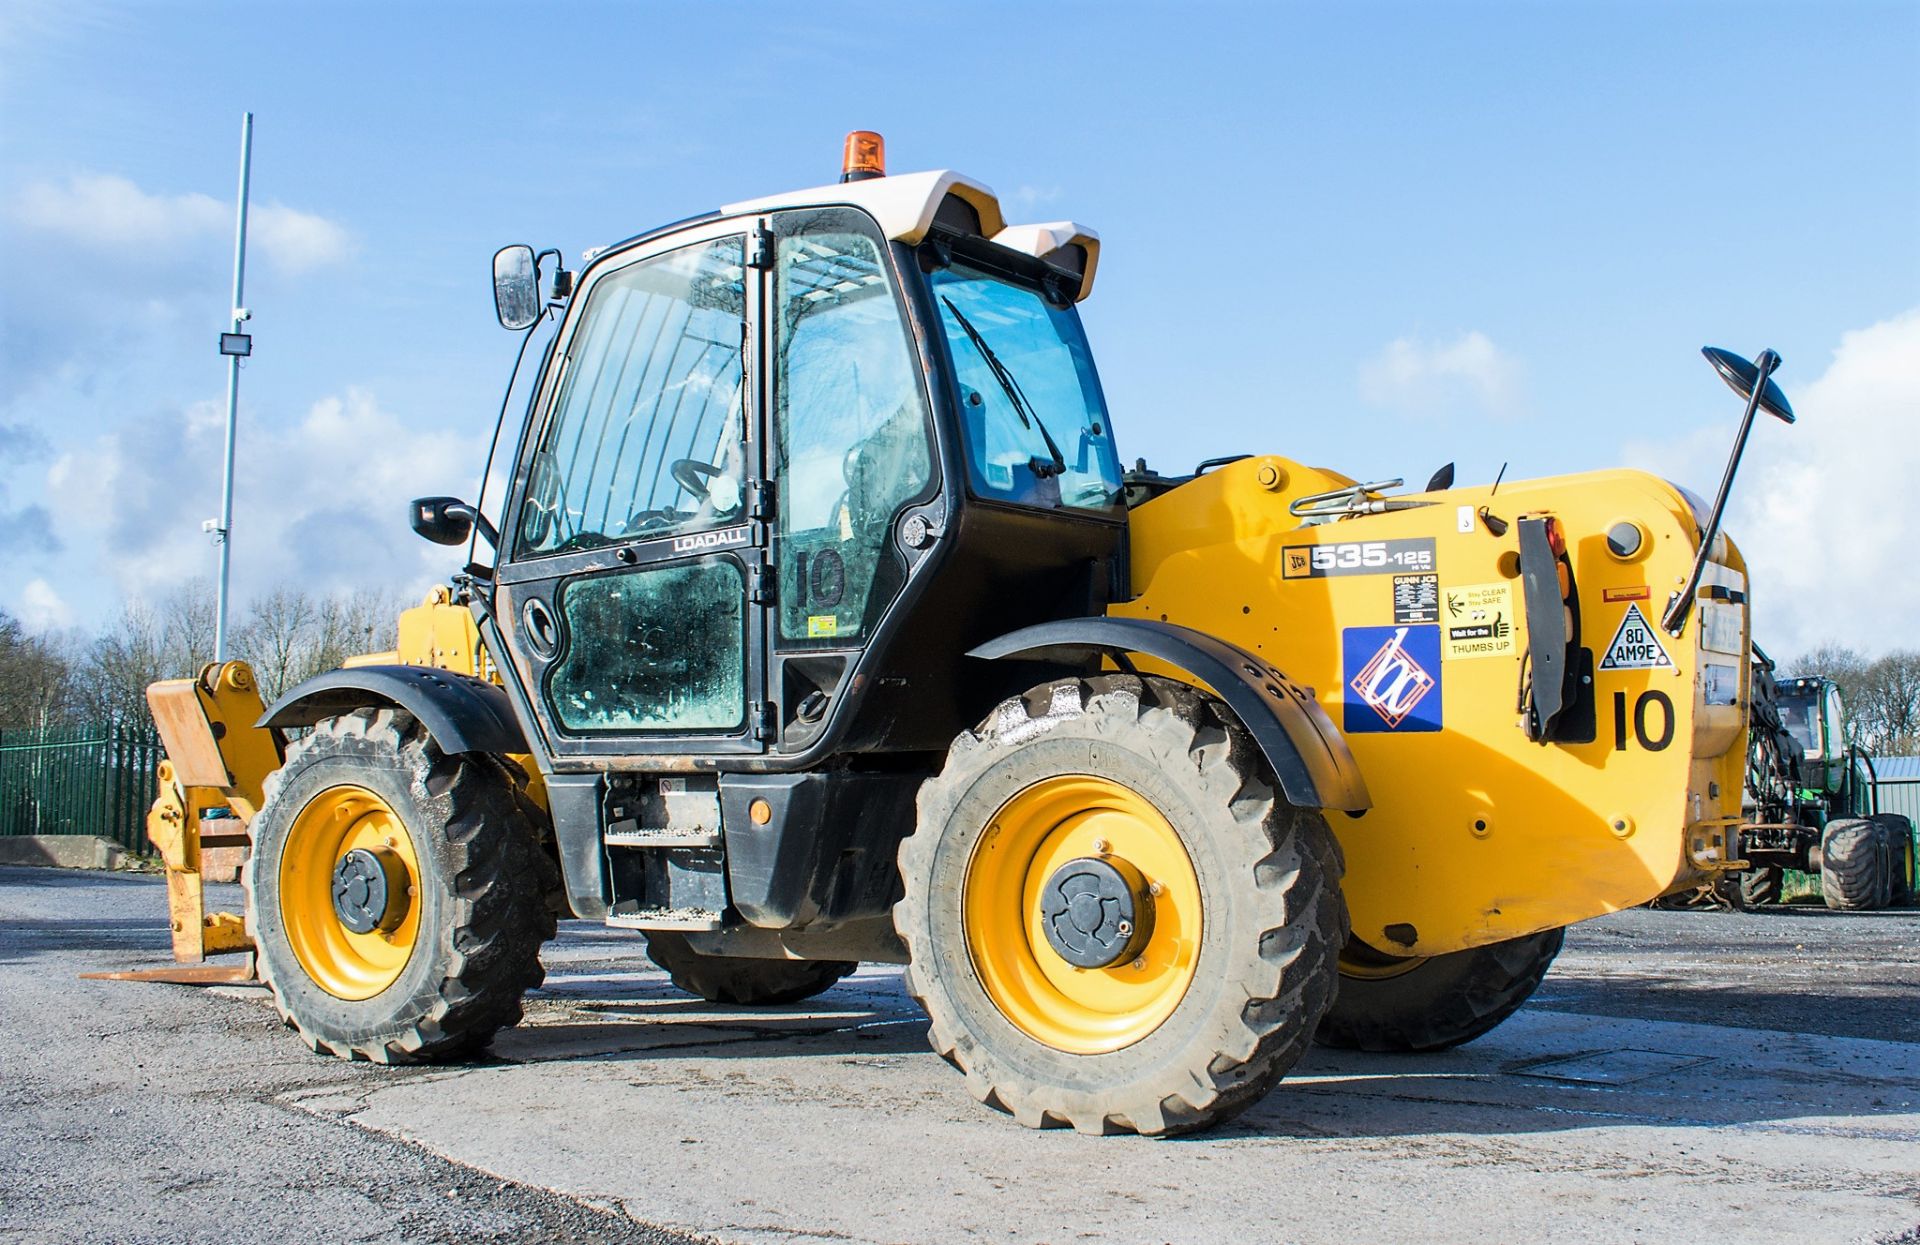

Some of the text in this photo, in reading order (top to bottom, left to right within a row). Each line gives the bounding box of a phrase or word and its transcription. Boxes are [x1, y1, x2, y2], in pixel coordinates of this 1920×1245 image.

[674, 530, 747, 552] LOADALL
[1291, 556, 1306, 569] JCB
[796, 548, 845, 609] 10
[1394, 575, 1437, 585] GUNN JCB
[1481, 588, 1506, 597] CLEAR
[1482, 597, 1502, 605] SAFE
[1477, 628, 1489, 636] the
[1452, 641, 1510, 654] THUMBS UP
[1615, 644, 1656, 662] AM9E
[1613, 689, 1676, 753] 10
